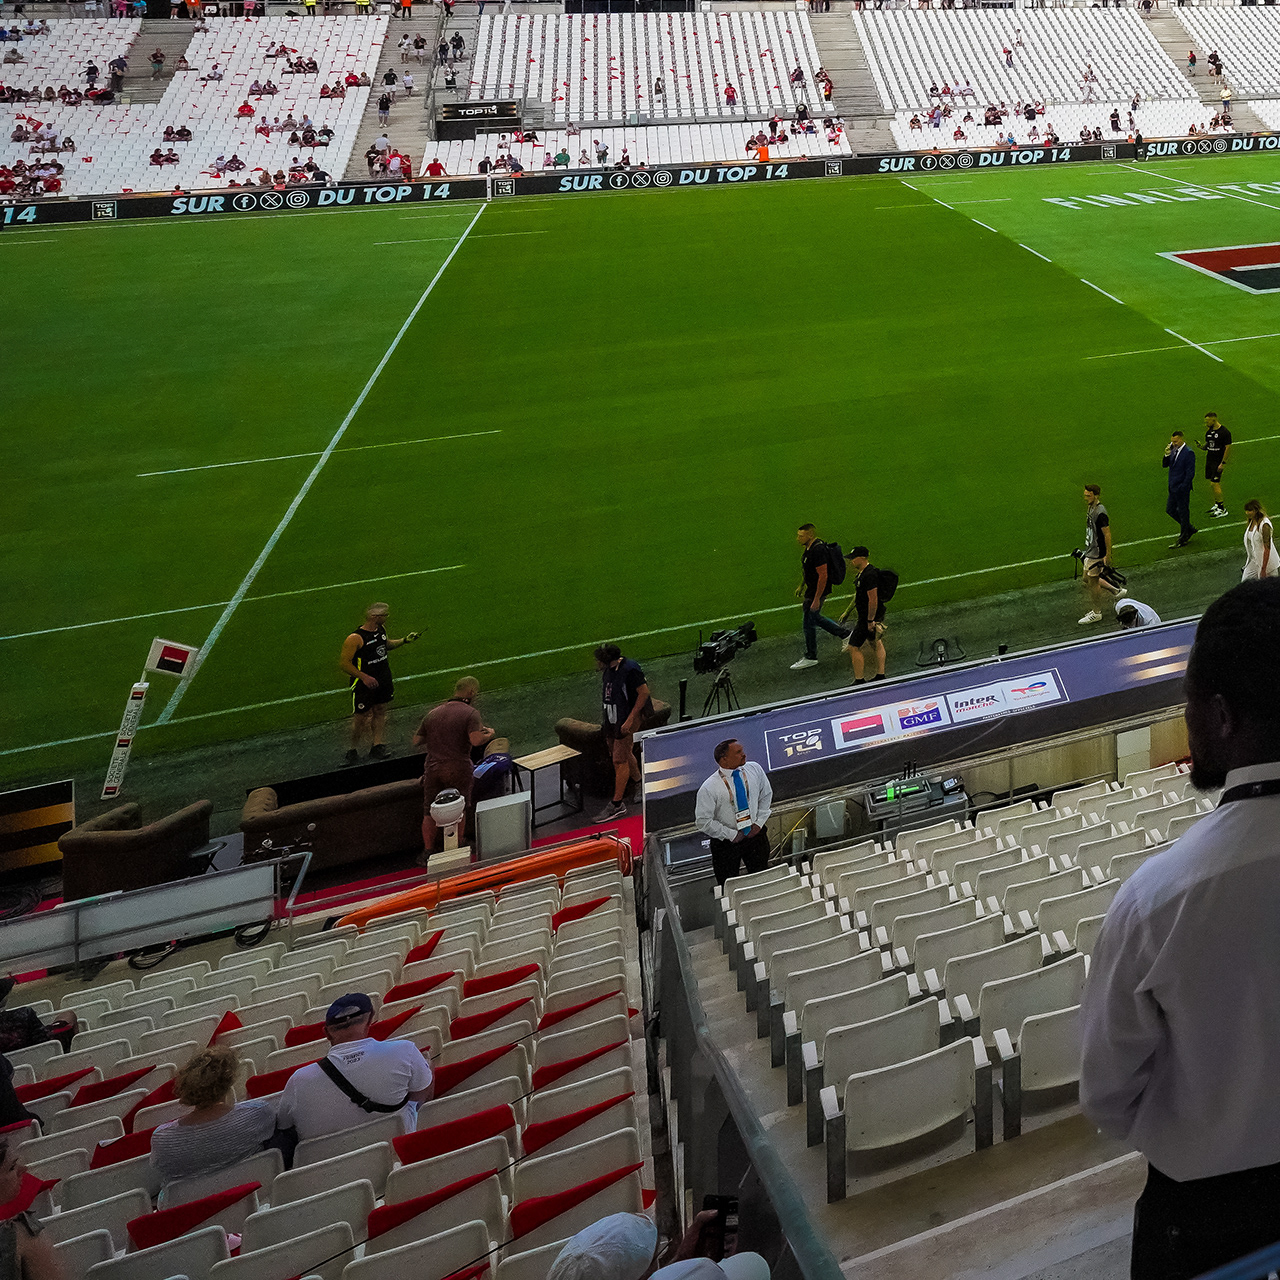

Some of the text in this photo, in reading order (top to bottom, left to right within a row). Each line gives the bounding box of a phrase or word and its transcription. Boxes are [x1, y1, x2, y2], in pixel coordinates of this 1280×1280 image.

[1147, 142, 1178, 157] SUR
[1231, 138, 1256, 152] DU
[878, 148, 1072, 172] SUR DU TOP 14
[558, 164, 788, 192] SUR DU TOP 14
[170, 182, 450, 214] SUR DU TOP 14
[1042, 188, 1226, 210] FINALE
[2, 205, 37, 223] 14
[954, 694, 1000, 711] Inter
[120, 708, 134, 736] SOCIETE
[126, 704, 142, 736] GENERALE
[903, 711, 940, 728] GMF
[778, 728, 822, 742] TOP
[784, 738, 822, 757] 14
[107, 756, 120, 784] SOCIETE
[114, 751, 127, 784] GENERALE
